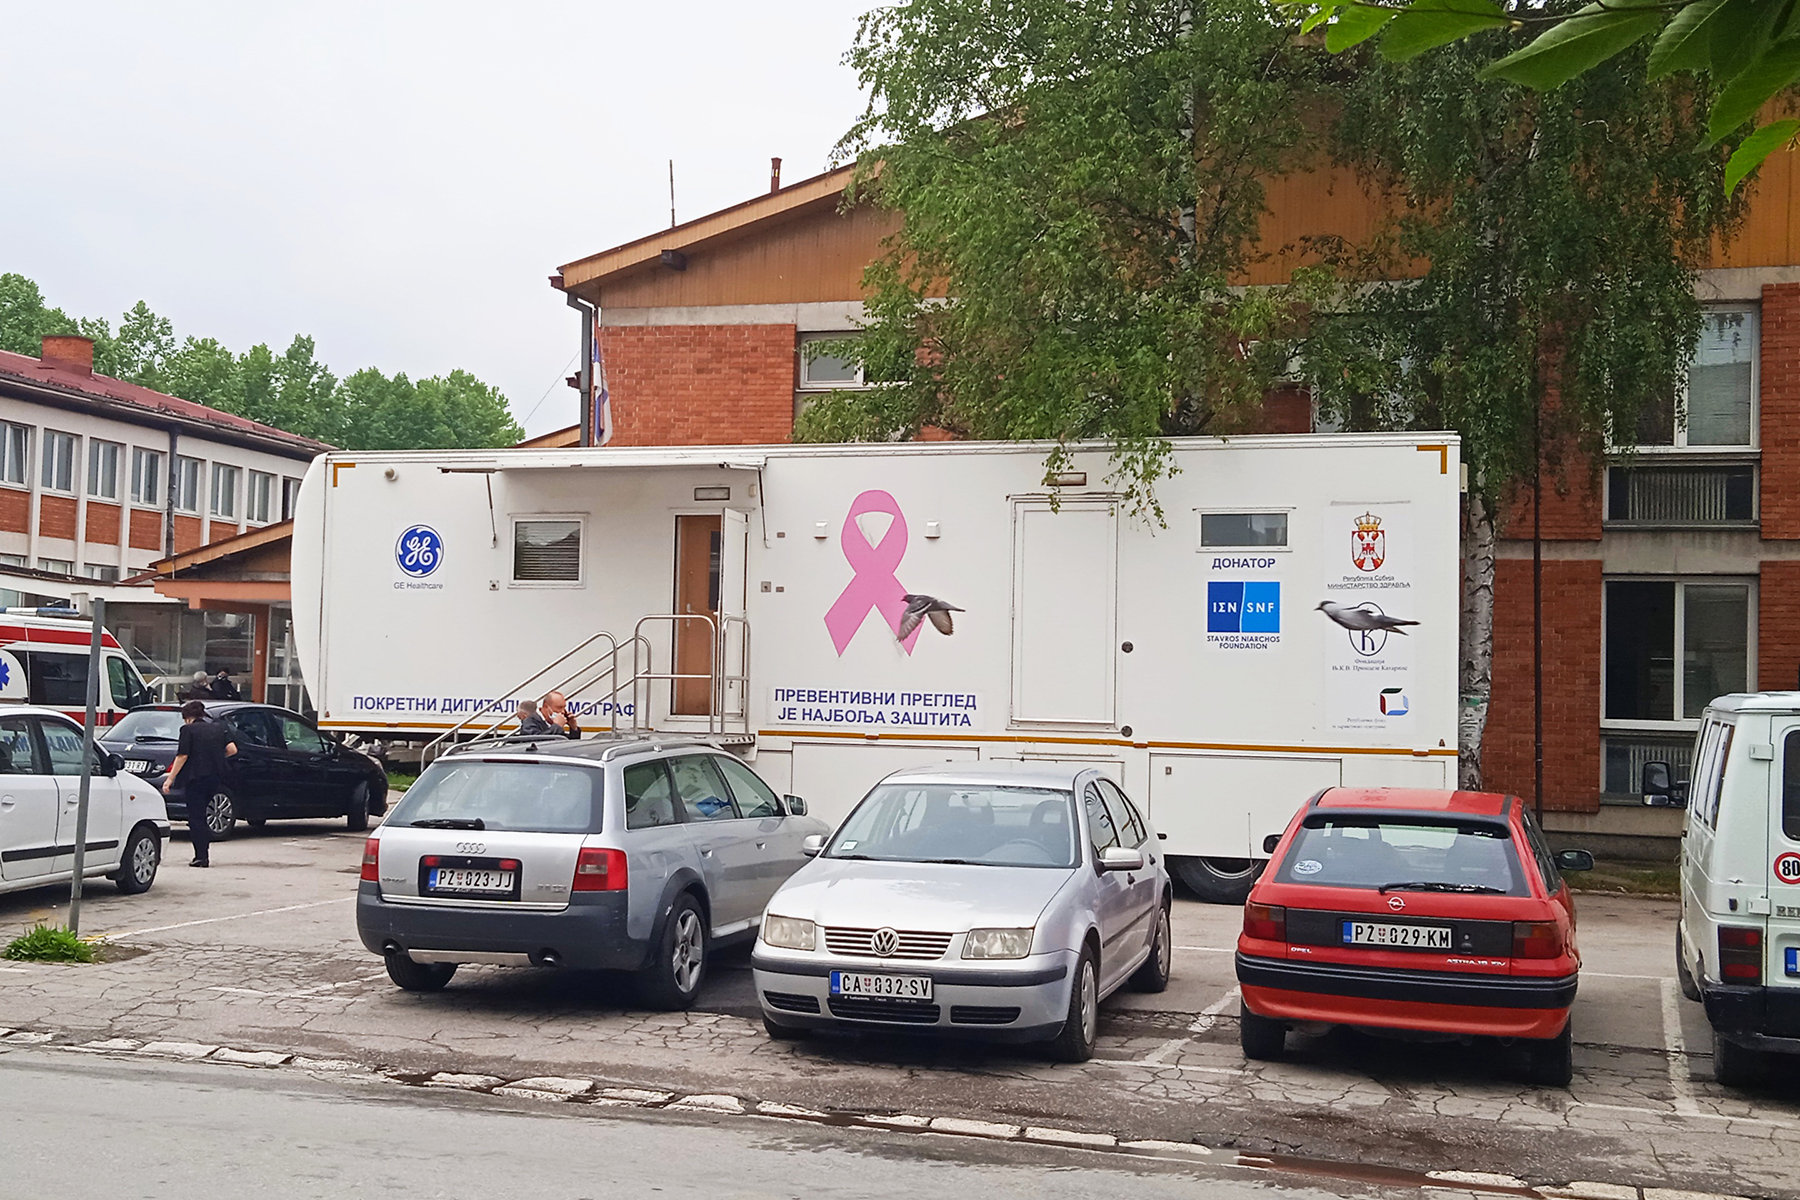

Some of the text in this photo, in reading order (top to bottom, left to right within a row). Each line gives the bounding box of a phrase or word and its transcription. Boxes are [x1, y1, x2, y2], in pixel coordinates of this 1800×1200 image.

[1212, 558, 1276, 570] ДОНАТОР
[393, 581, 444, 590] GE Healthcare
[1246, 602, 1275, 613] SNF
[353, 696, 437, 712] ПОКРЕТНИ
[440, 698, 519, 714] ДИГИТАЛ
[775, 688, 977, 710] ПРЕВЕНТИВНИ ПРЕГЛЕД
[778, 707, 972, 727] ЈЕ НАЈБОЉА ЗАШТИТА
[1782, 860, 1800, 877] 80
[438, 869, 455, 886] PZ
[1354, 924, 1375, 943] PZ
[842, 974, 862, 992] CA
